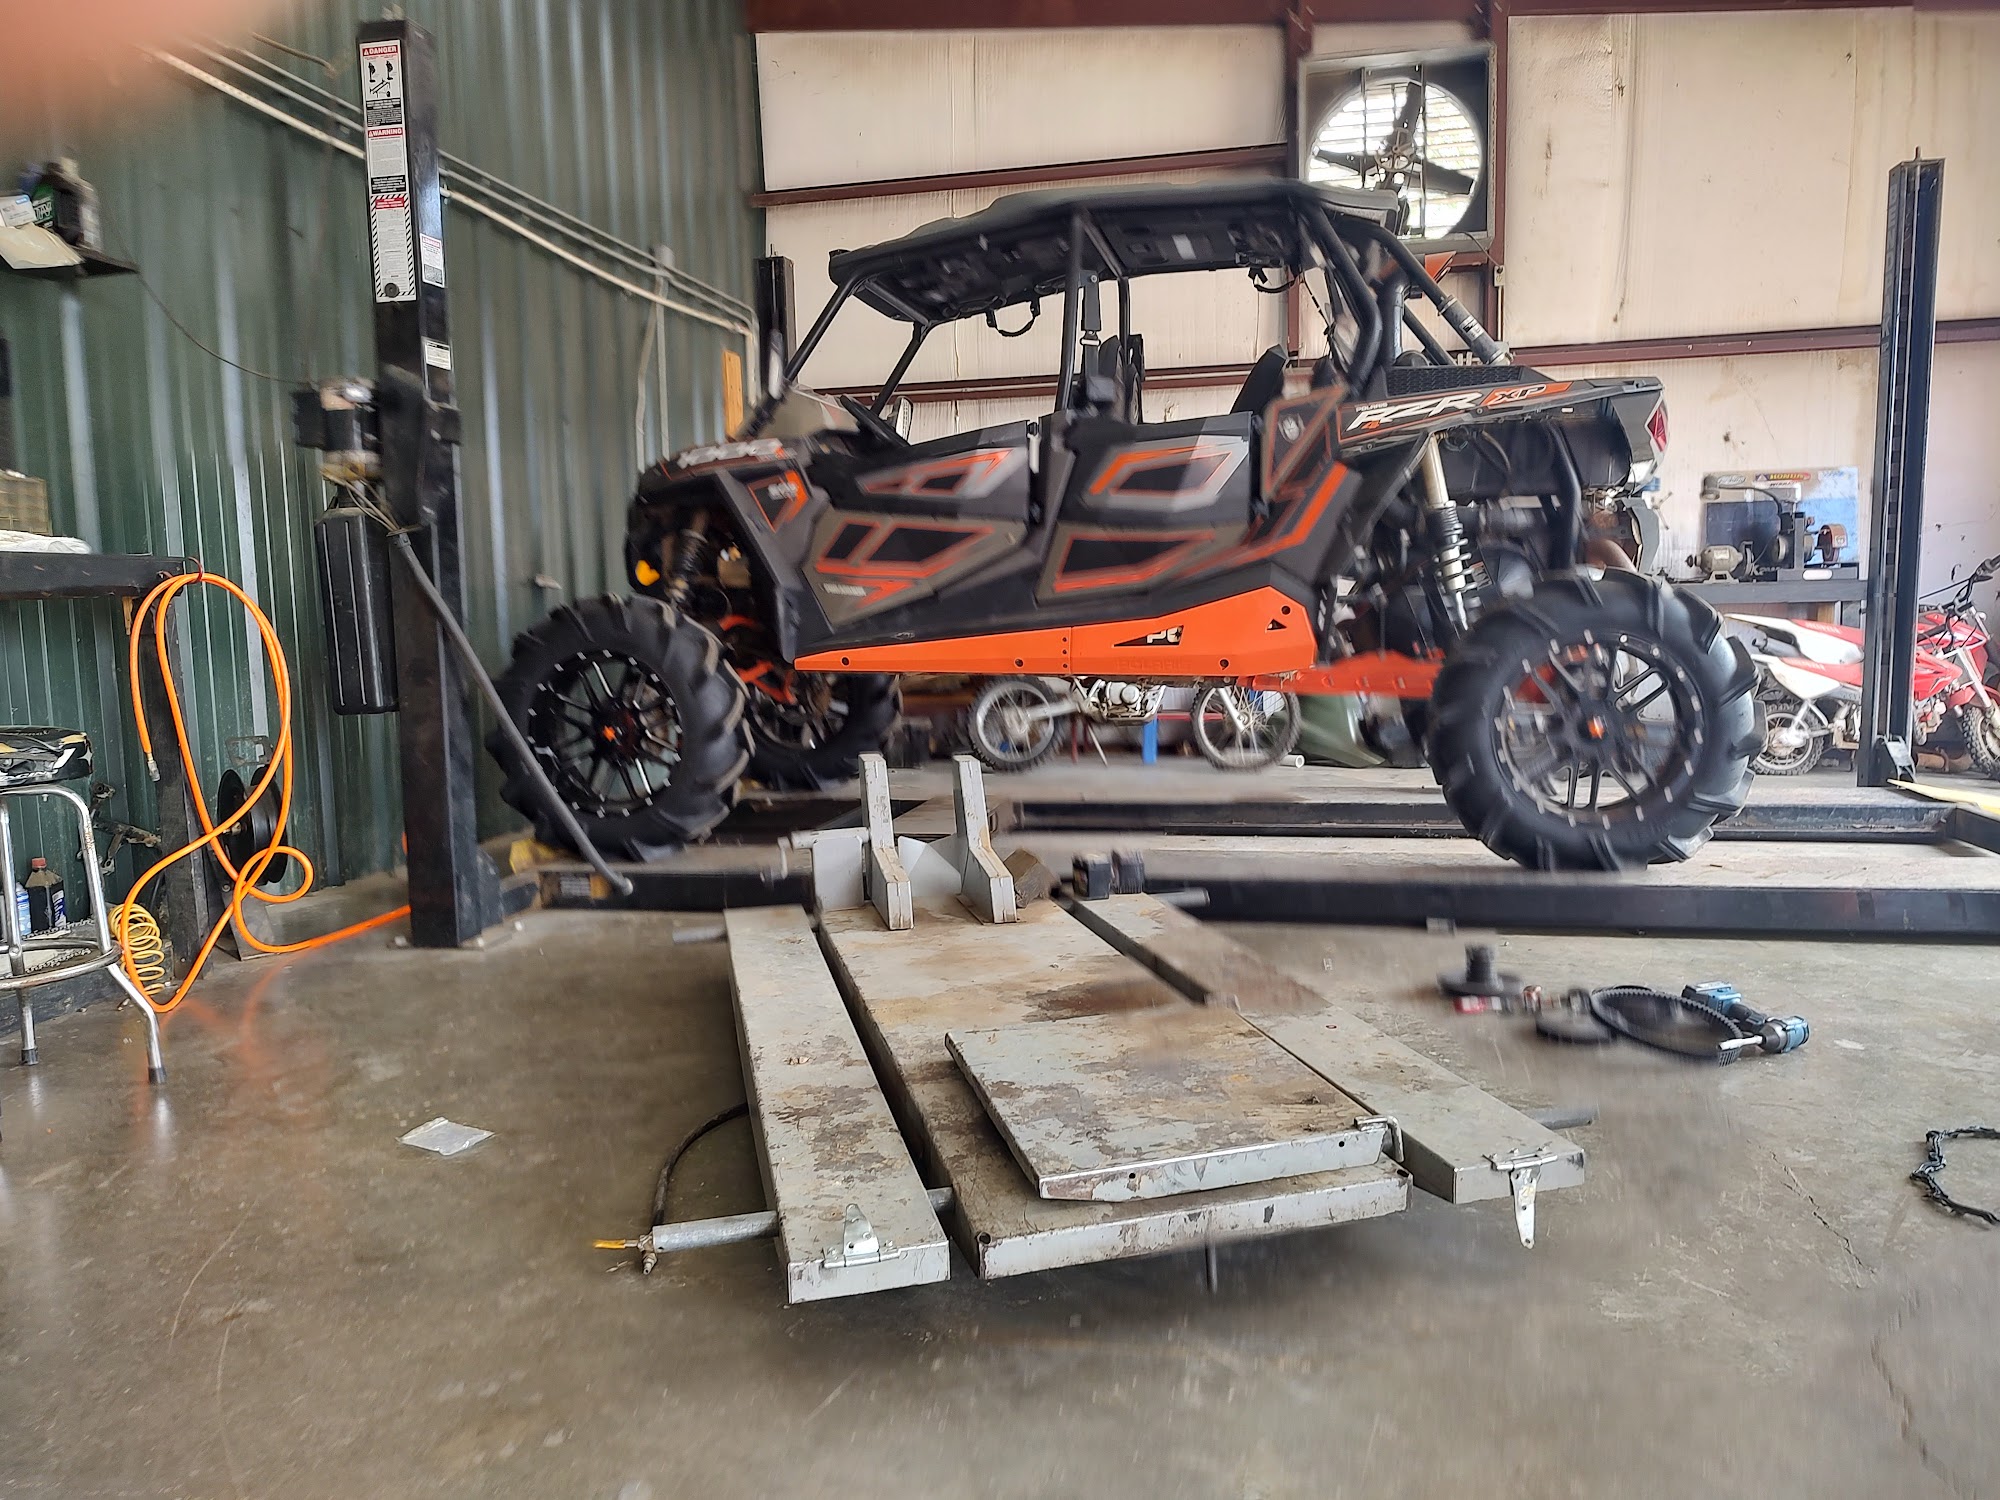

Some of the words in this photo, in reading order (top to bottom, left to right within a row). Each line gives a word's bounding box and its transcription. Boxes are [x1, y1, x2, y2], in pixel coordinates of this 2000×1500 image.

[368, 45, 397, 55] DANGER
[373, 128, 402, 136] WARNING
[1490, 384, 1546, 405] XP
[1346, 392, 1482, 431] RZR
[1356, 402, 1388, 412] POLARIS
